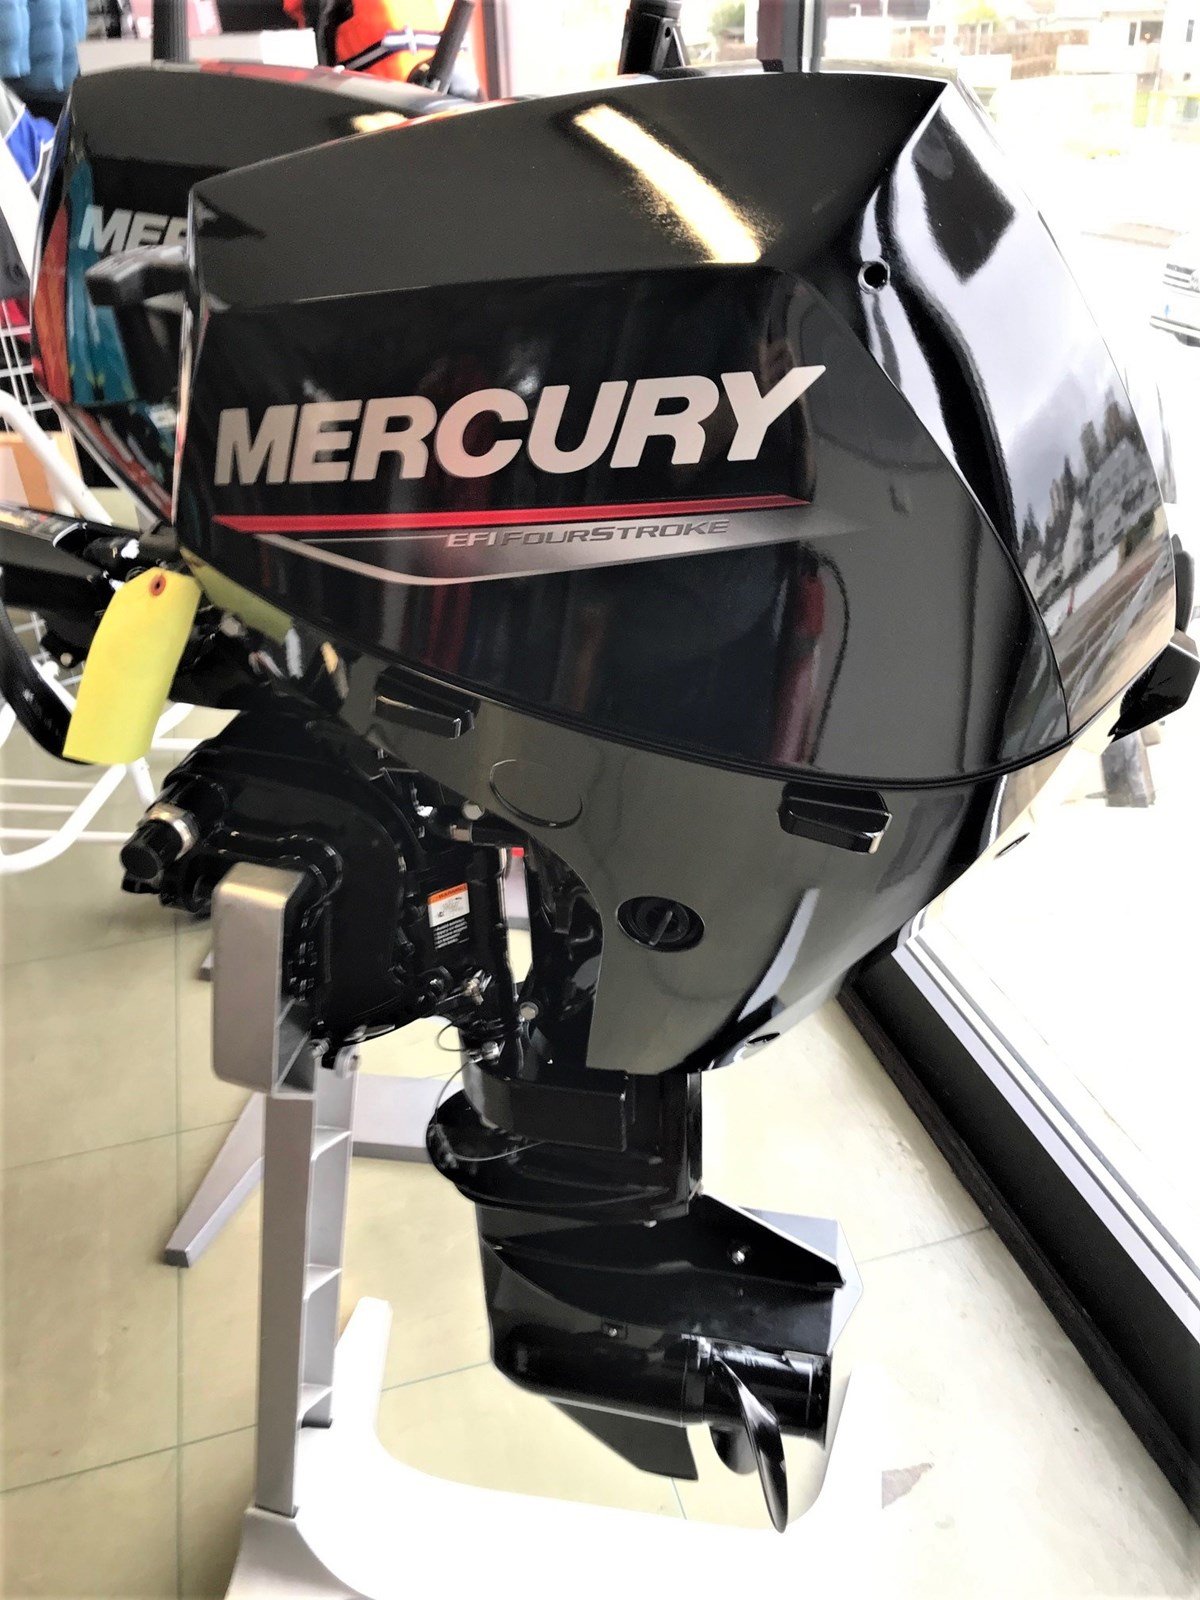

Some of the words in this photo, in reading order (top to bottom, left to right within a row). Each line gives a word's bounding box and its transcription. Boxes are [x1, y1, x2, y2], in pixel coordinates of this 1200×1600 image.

[214, 365, 826, 486] MERCURY
[446, 531, 498, 548] EFI
[500, 520, 731, 546] FOURSTROKE
